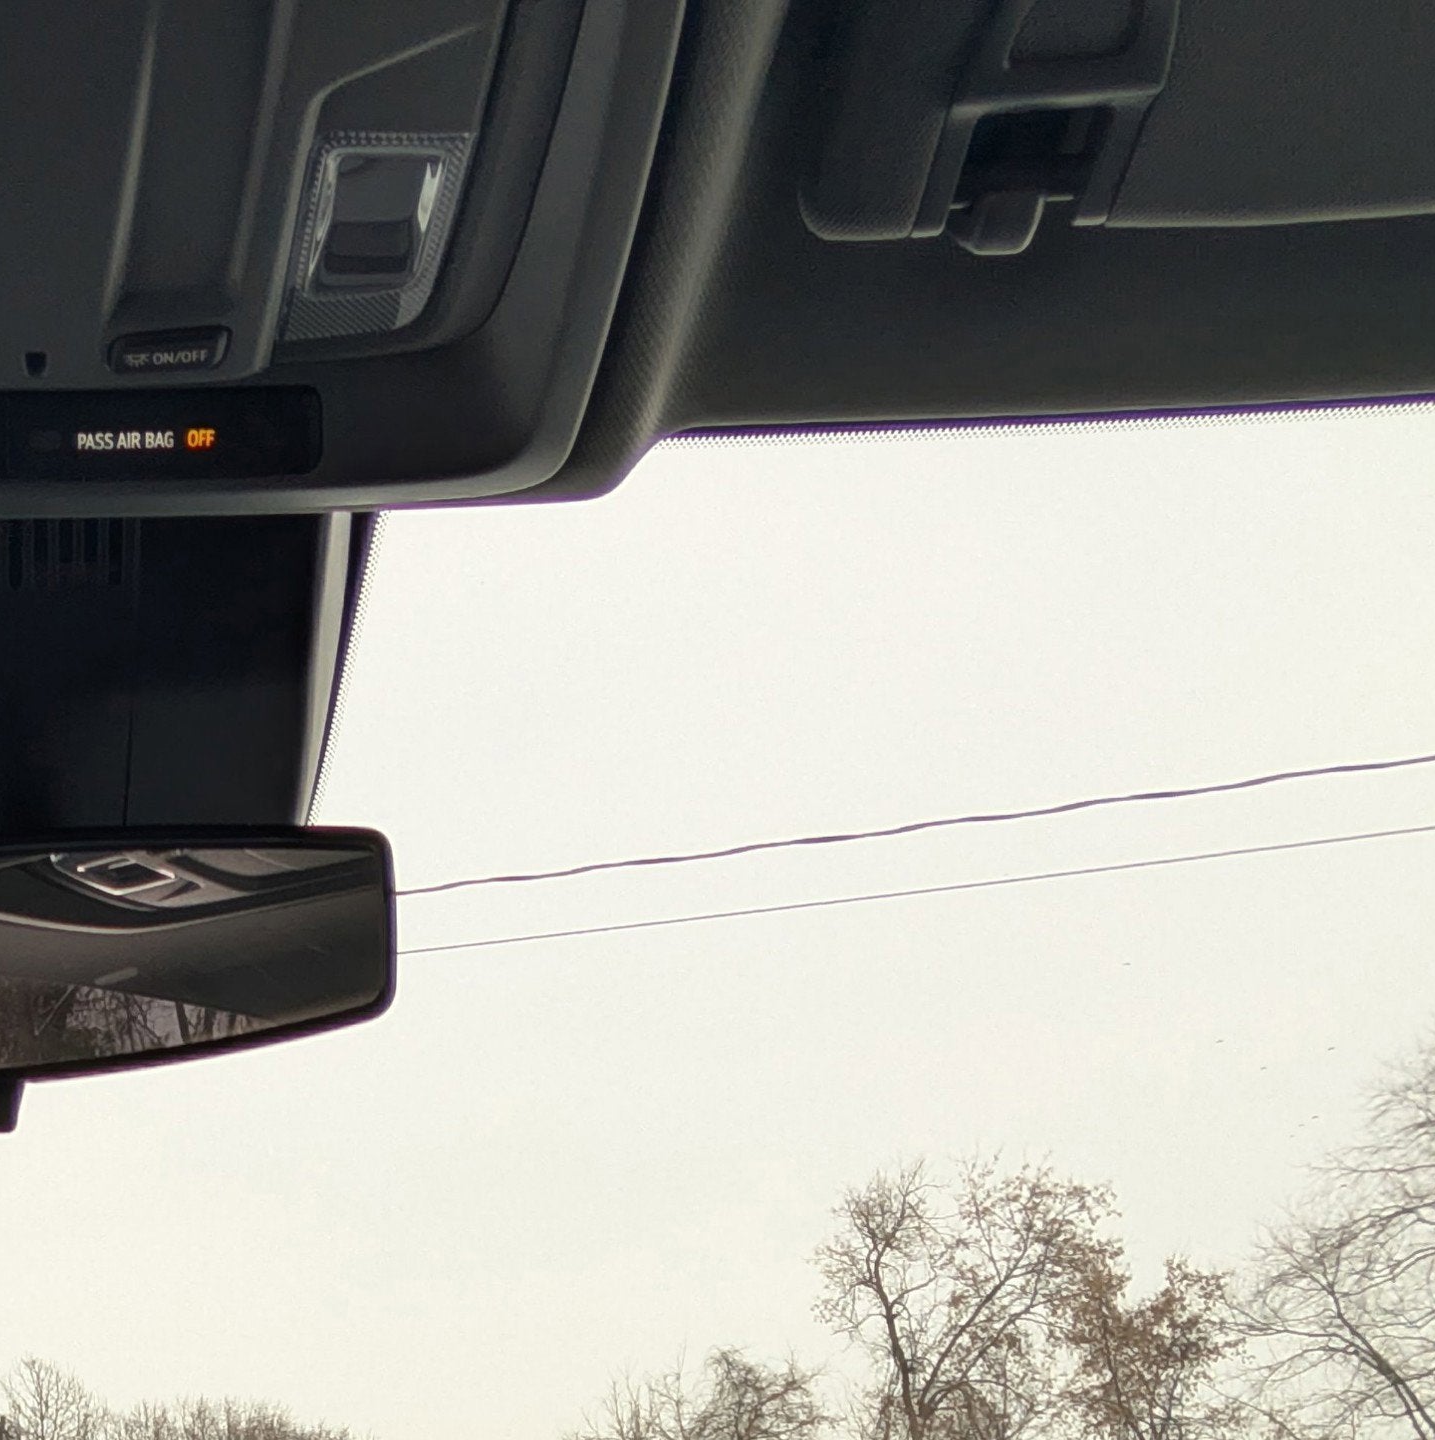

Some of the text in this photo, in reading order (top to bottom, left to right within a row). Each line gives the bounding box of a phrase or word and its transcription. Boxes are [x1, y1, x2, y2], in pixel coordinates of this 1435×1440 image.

[152, 349, 208, 366] ON/OFF
[76, 429, 215, 450] PASS AIR BAG OFF
